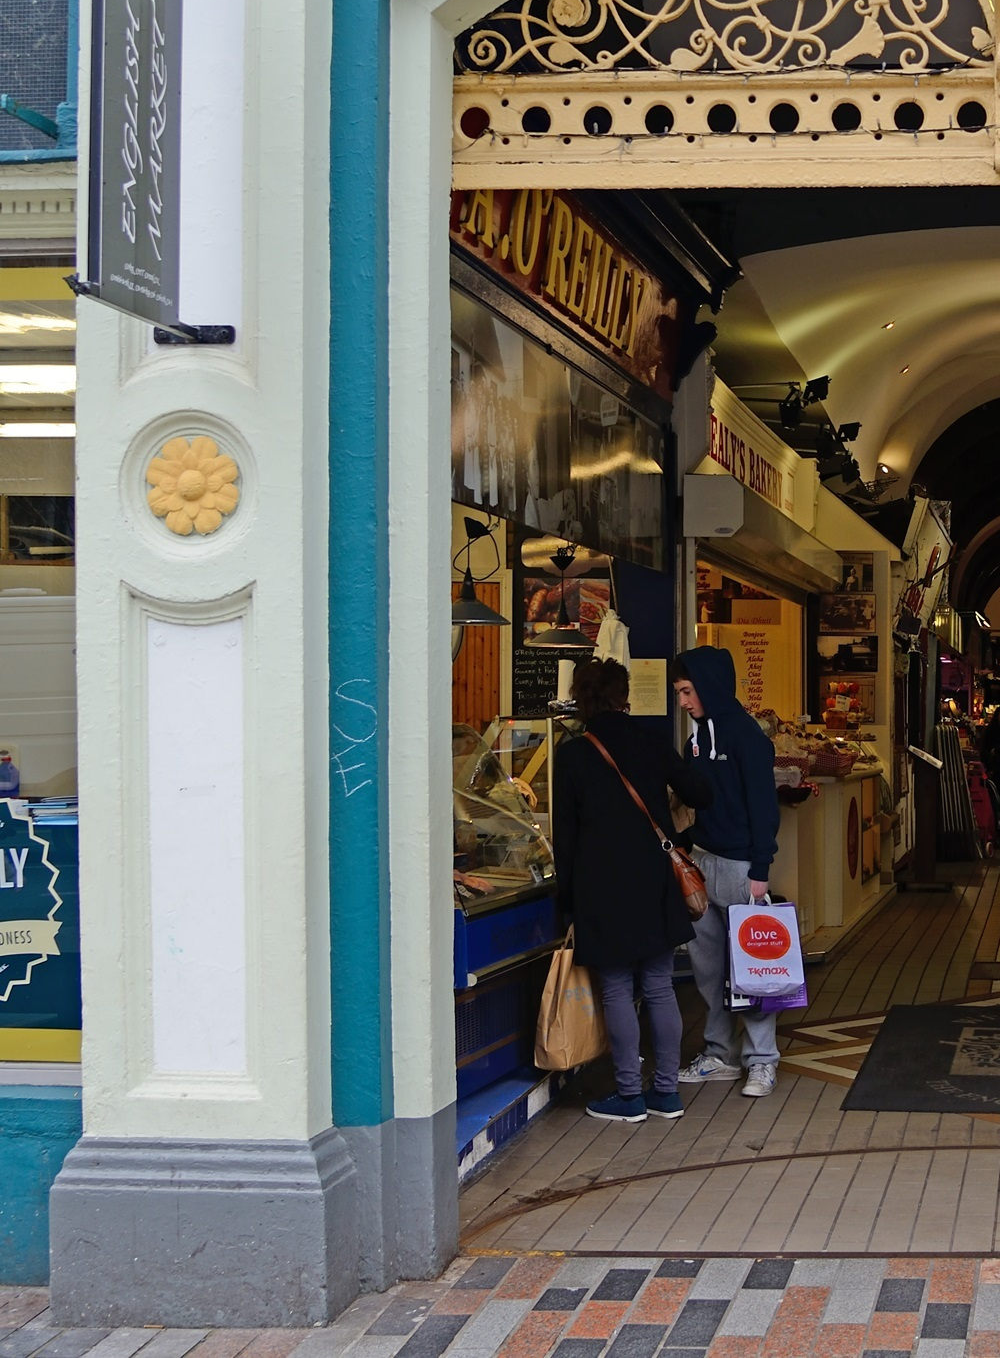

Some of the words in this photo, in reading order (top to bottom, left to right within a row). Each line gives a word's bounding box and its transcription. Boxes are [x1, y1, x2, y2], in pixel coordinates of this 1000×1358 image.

[707, 413, 745, 483] EALY'S
[749, 447, 783, 509] BAKERY
[746, 655, 764, 663] Aloha
[750, 927, 778, 940] love
[925, 1079, 958, 1096] THE
